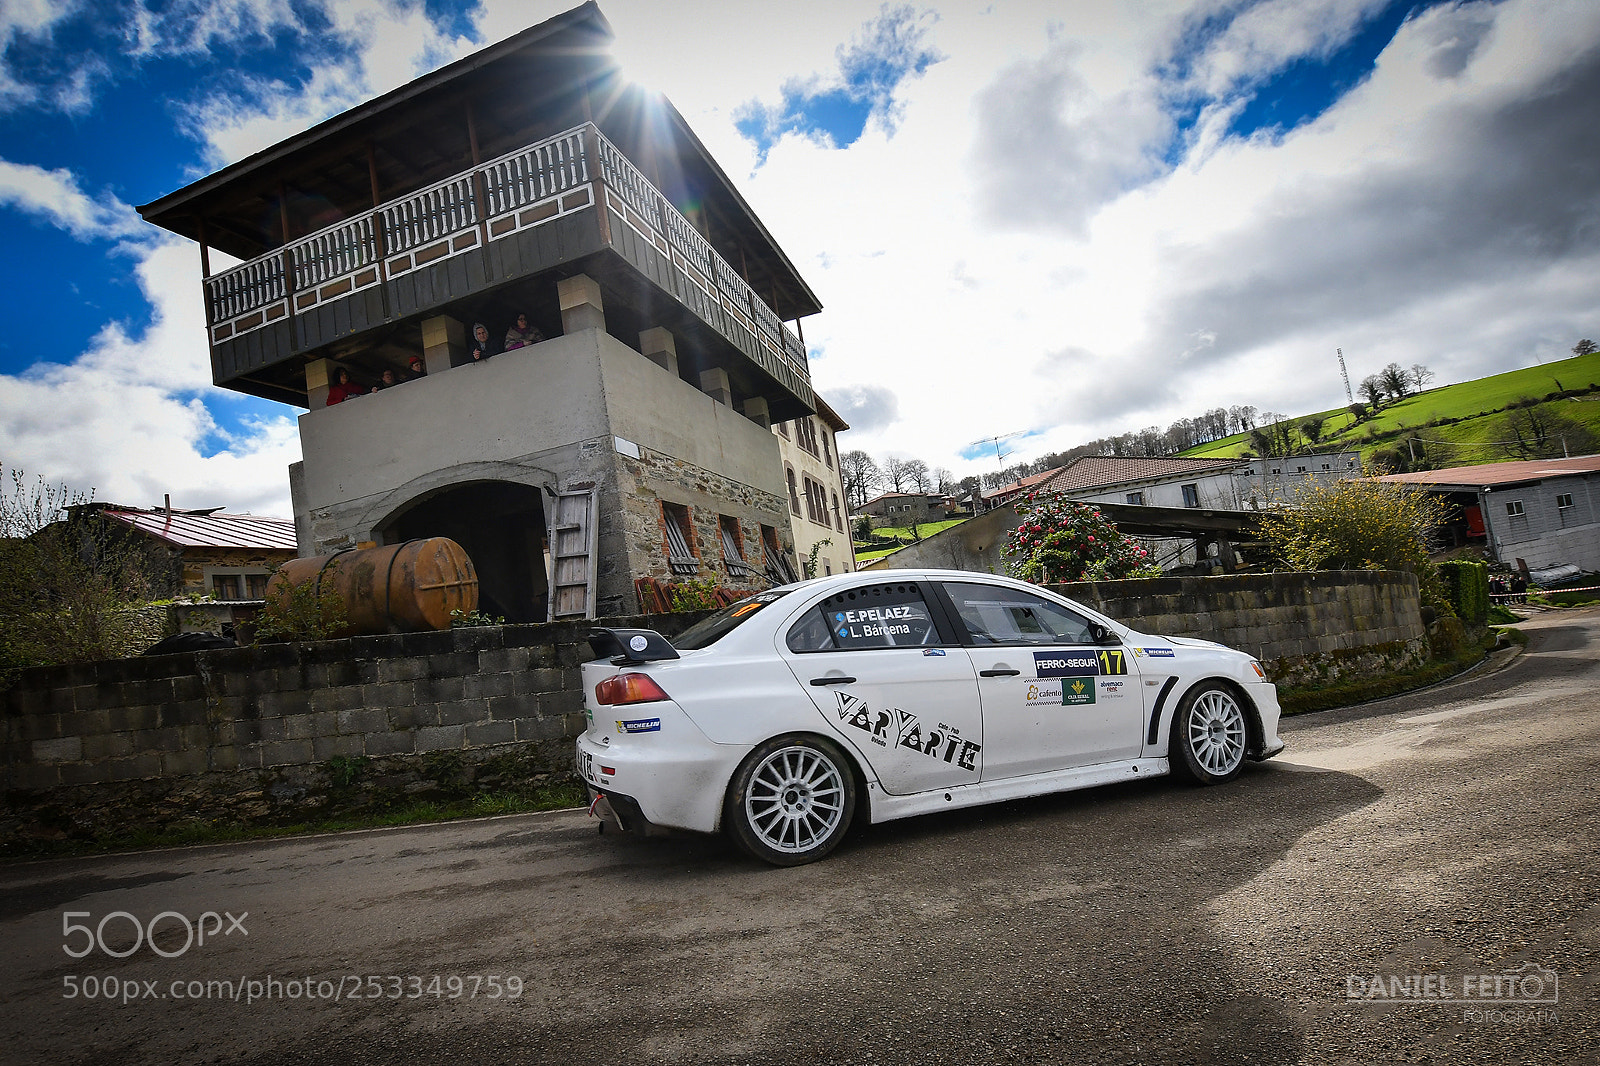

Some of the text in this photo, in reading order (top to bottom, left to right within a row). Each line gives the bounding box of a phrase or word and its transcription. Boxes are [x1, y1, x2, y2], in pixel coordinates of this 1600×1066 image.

[845, 606, 912, 623] E.PELAEZ
[849, 626, 862, 638] L.
[863, 623, 911, 638] Bárcena
[1036, 658, 1098, 670] FERRO-SEGUR
[1099, 651, 1123, 675] 17
[1039, 689, 1062, 698] cafento
[626, 721, 660, 729] MICHELIN
